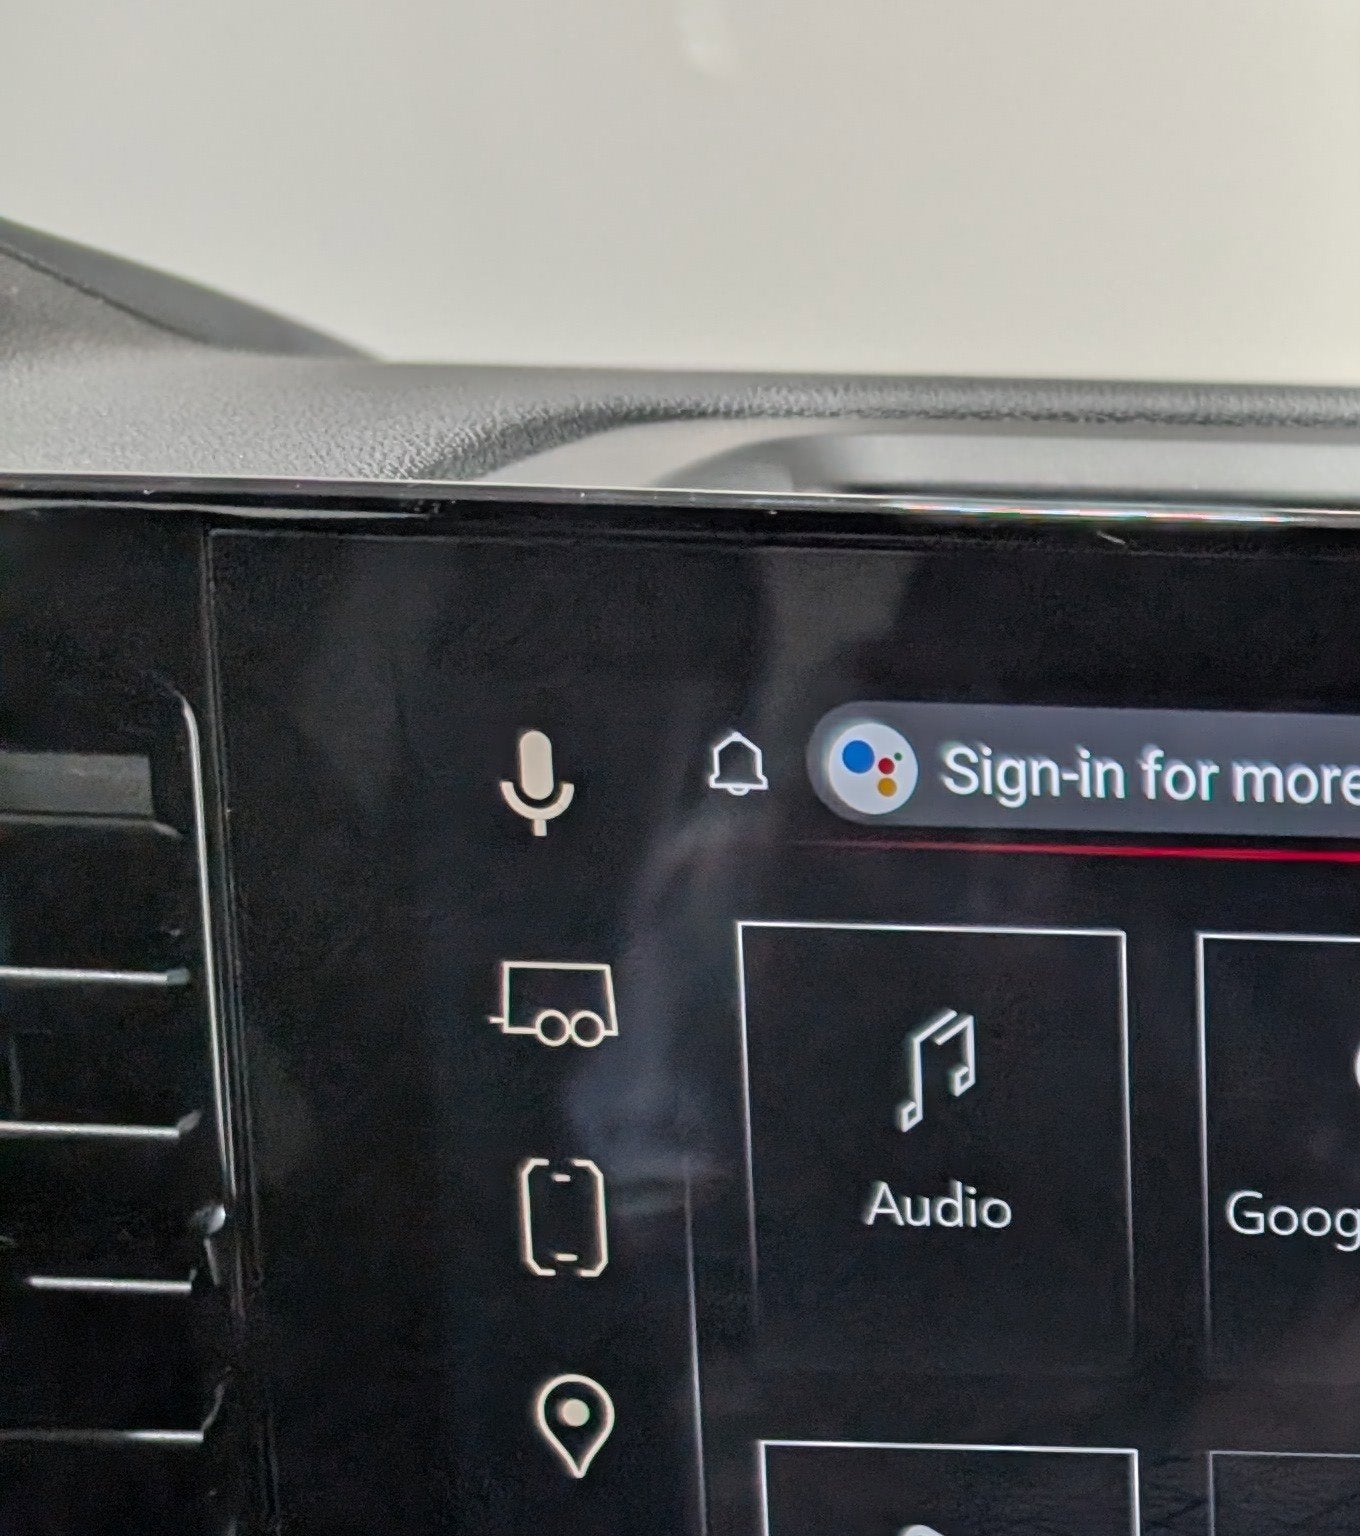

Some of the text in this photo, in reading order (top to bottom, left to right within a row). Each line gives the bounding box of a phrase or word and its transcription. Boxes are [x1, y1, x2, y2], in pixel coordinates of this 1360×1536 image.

[940, 744, 1125, 806] Sign-in
[1141, 746, 1221, 802] for
[863, 1180, 1013, 1230] Audio
